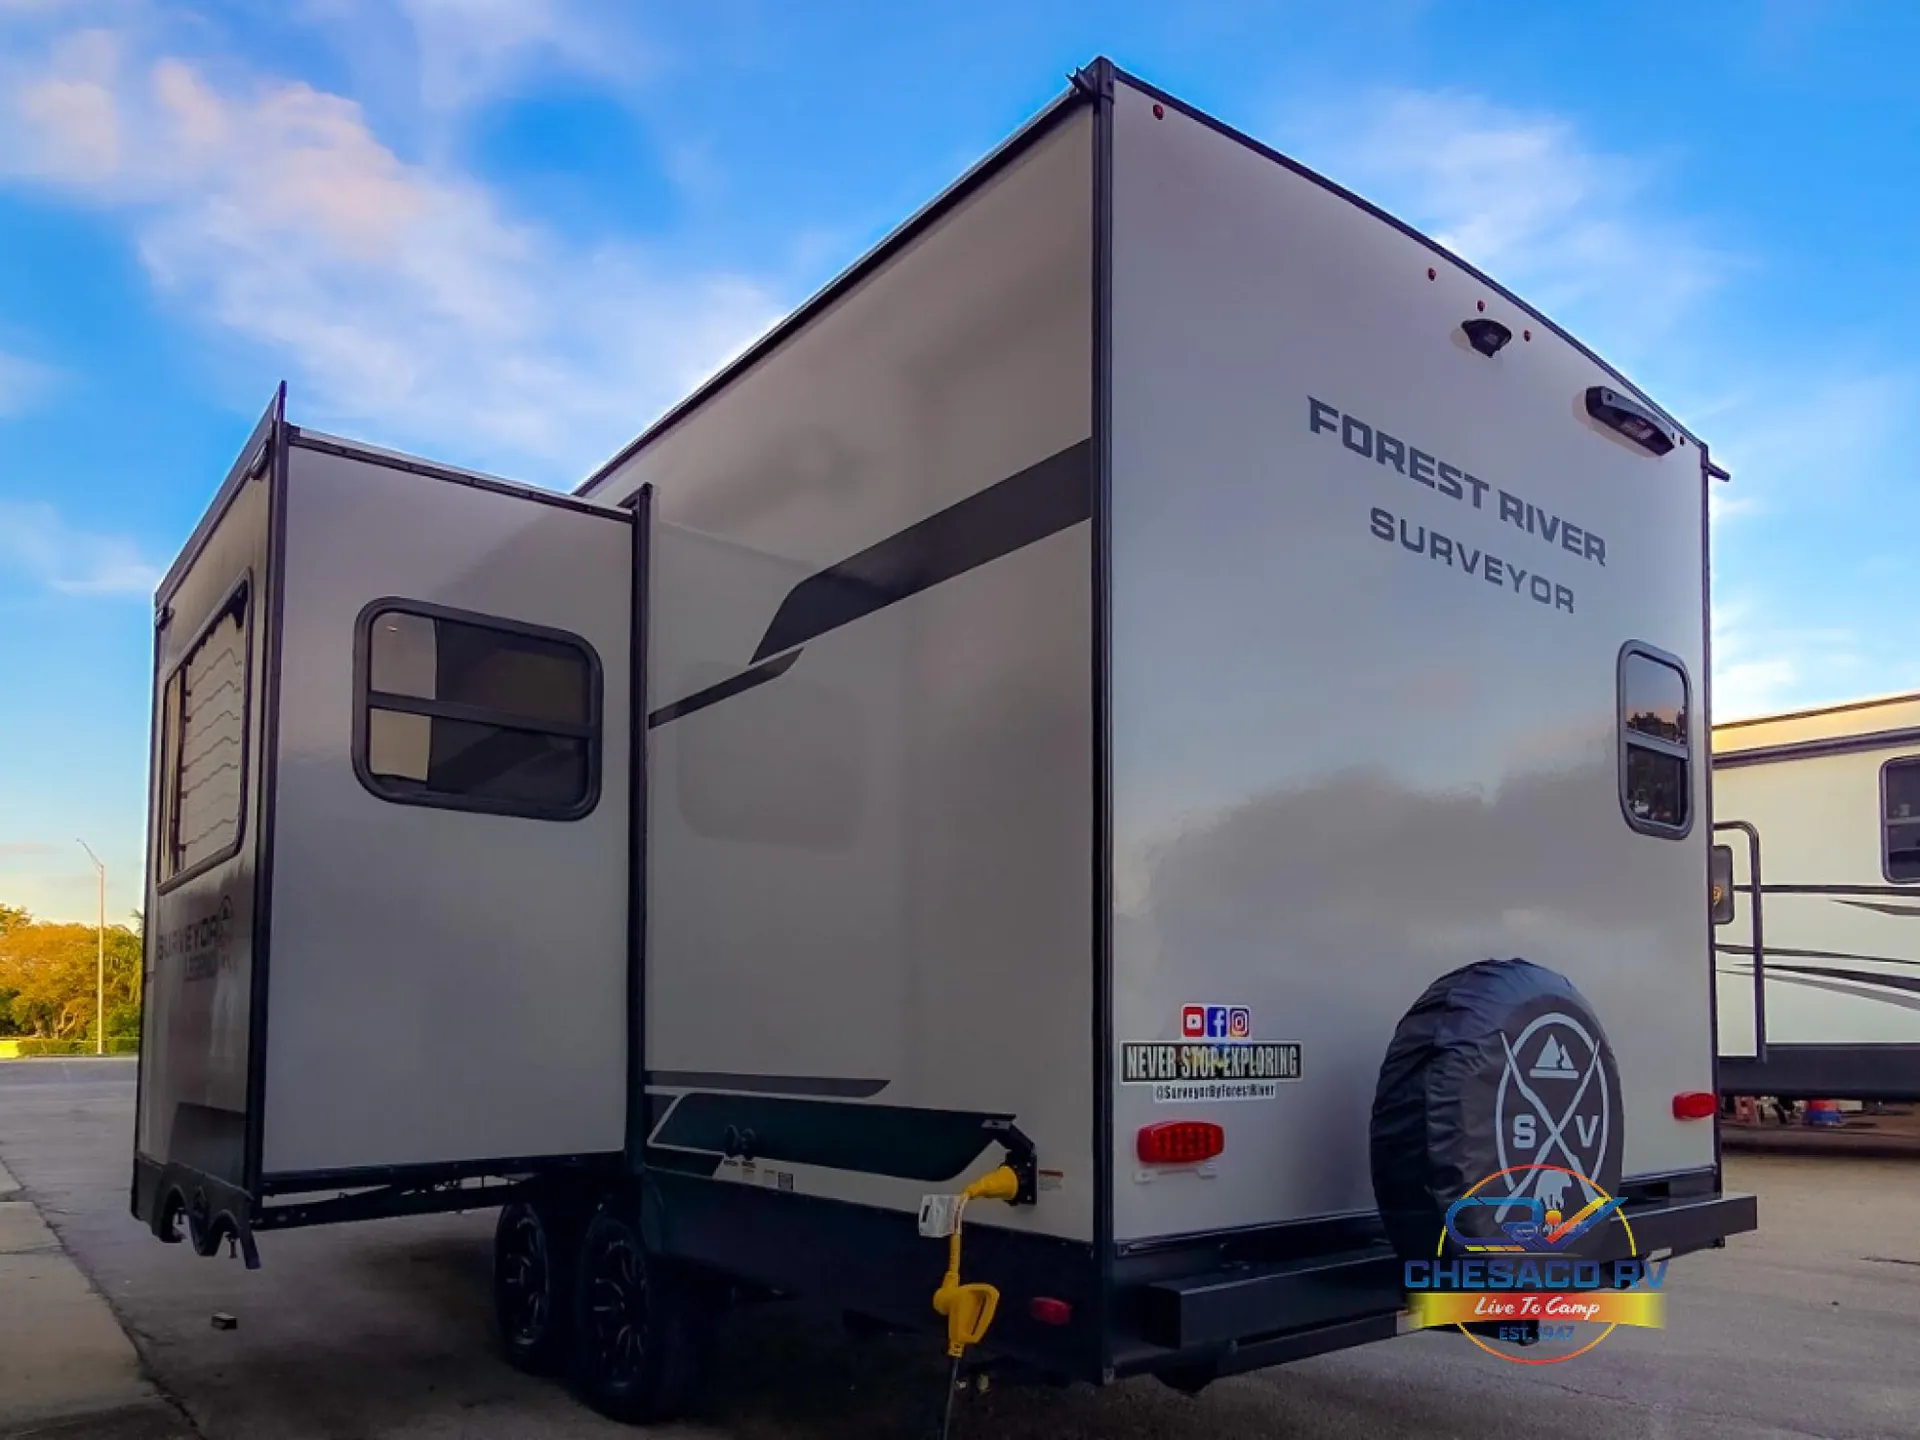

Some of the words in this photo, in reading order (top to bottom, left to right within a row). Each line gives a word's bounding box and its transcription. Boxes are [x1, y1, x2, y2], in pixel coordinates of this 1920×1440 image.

[1307, 395, 1490, 509] FOREST
[1498, 489, 1607, 567] RIVER
[1369, 506, 1575, 614] SURVEYOR
[1126, 1045, 1177, 1079] NEVER
[1180, 1045, 1219, 1078] STOP
[1223, 1046, 1298, 1078] EXPLORING
